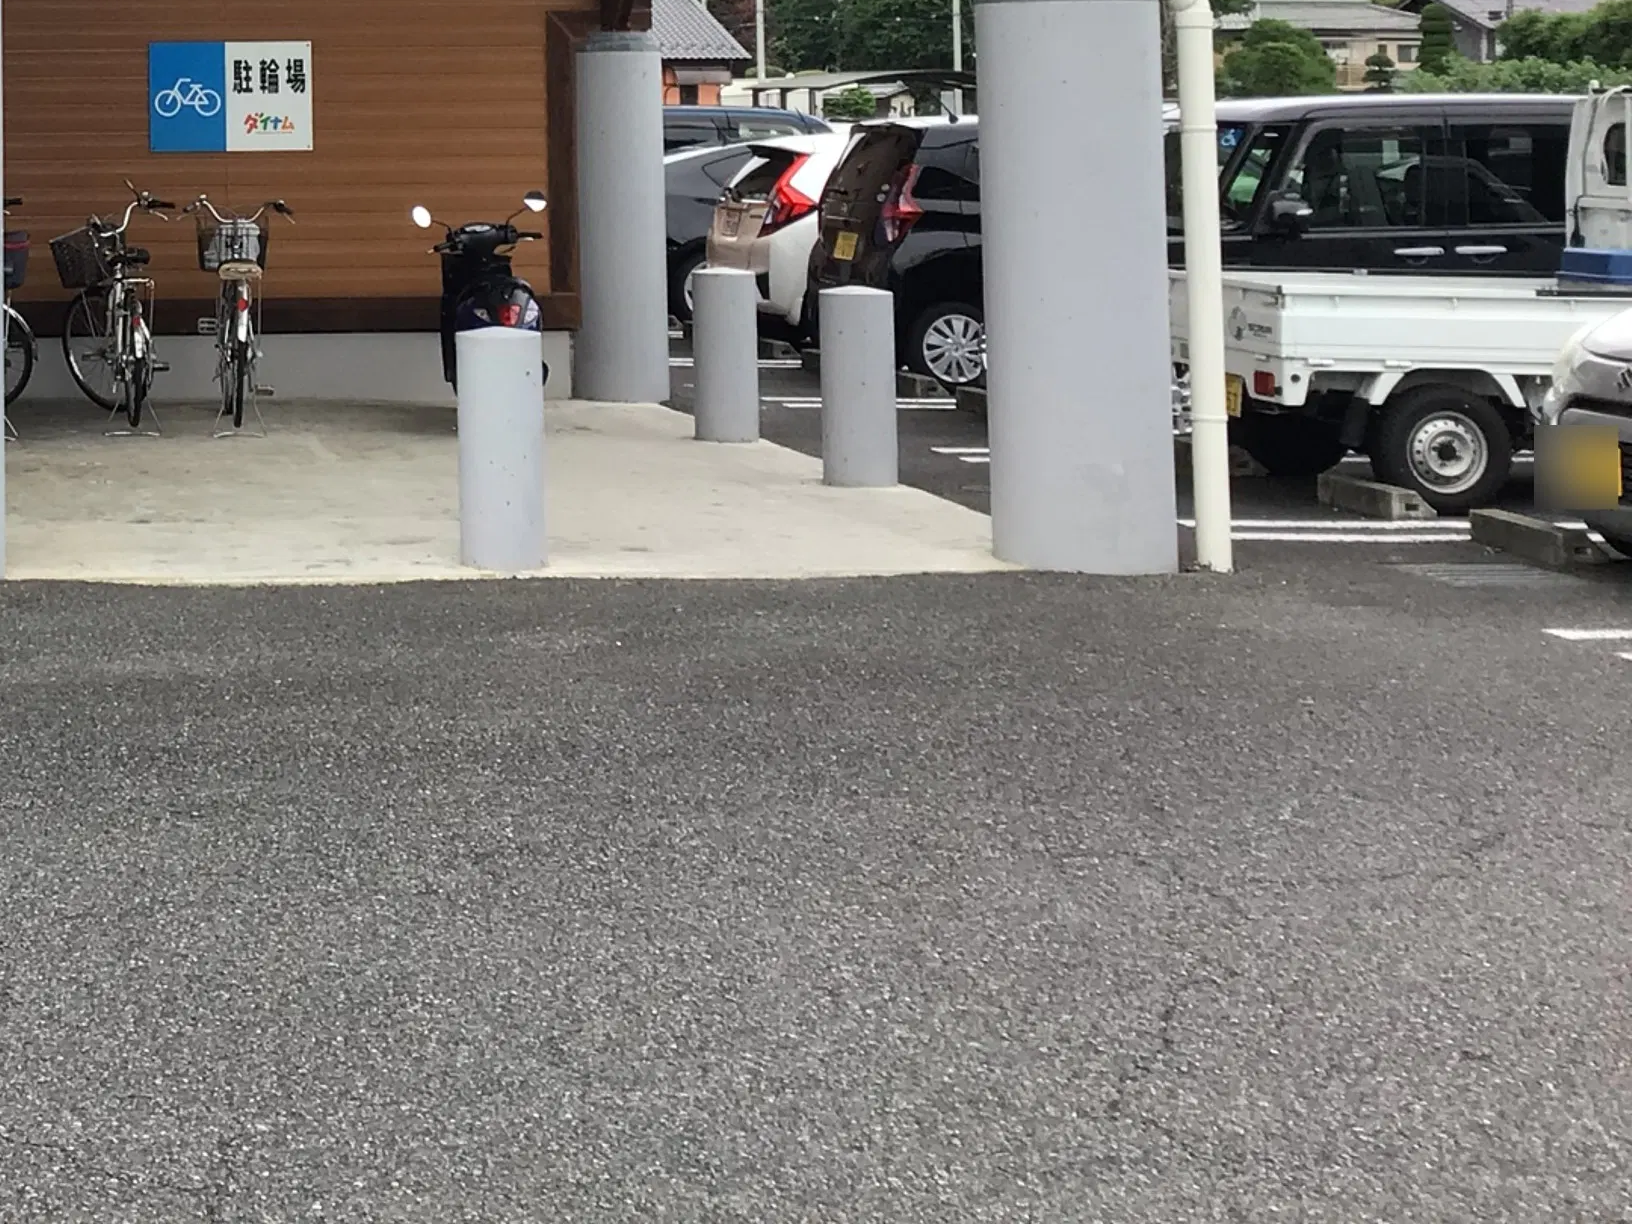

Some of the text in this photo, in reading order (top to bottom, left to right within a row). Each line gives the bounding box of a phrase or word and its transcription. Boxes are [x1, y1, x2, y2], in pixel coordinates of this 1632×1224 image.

[232, 58, 306, 94] 駐輪場
[244, 112, 295, 134] ダイナム
